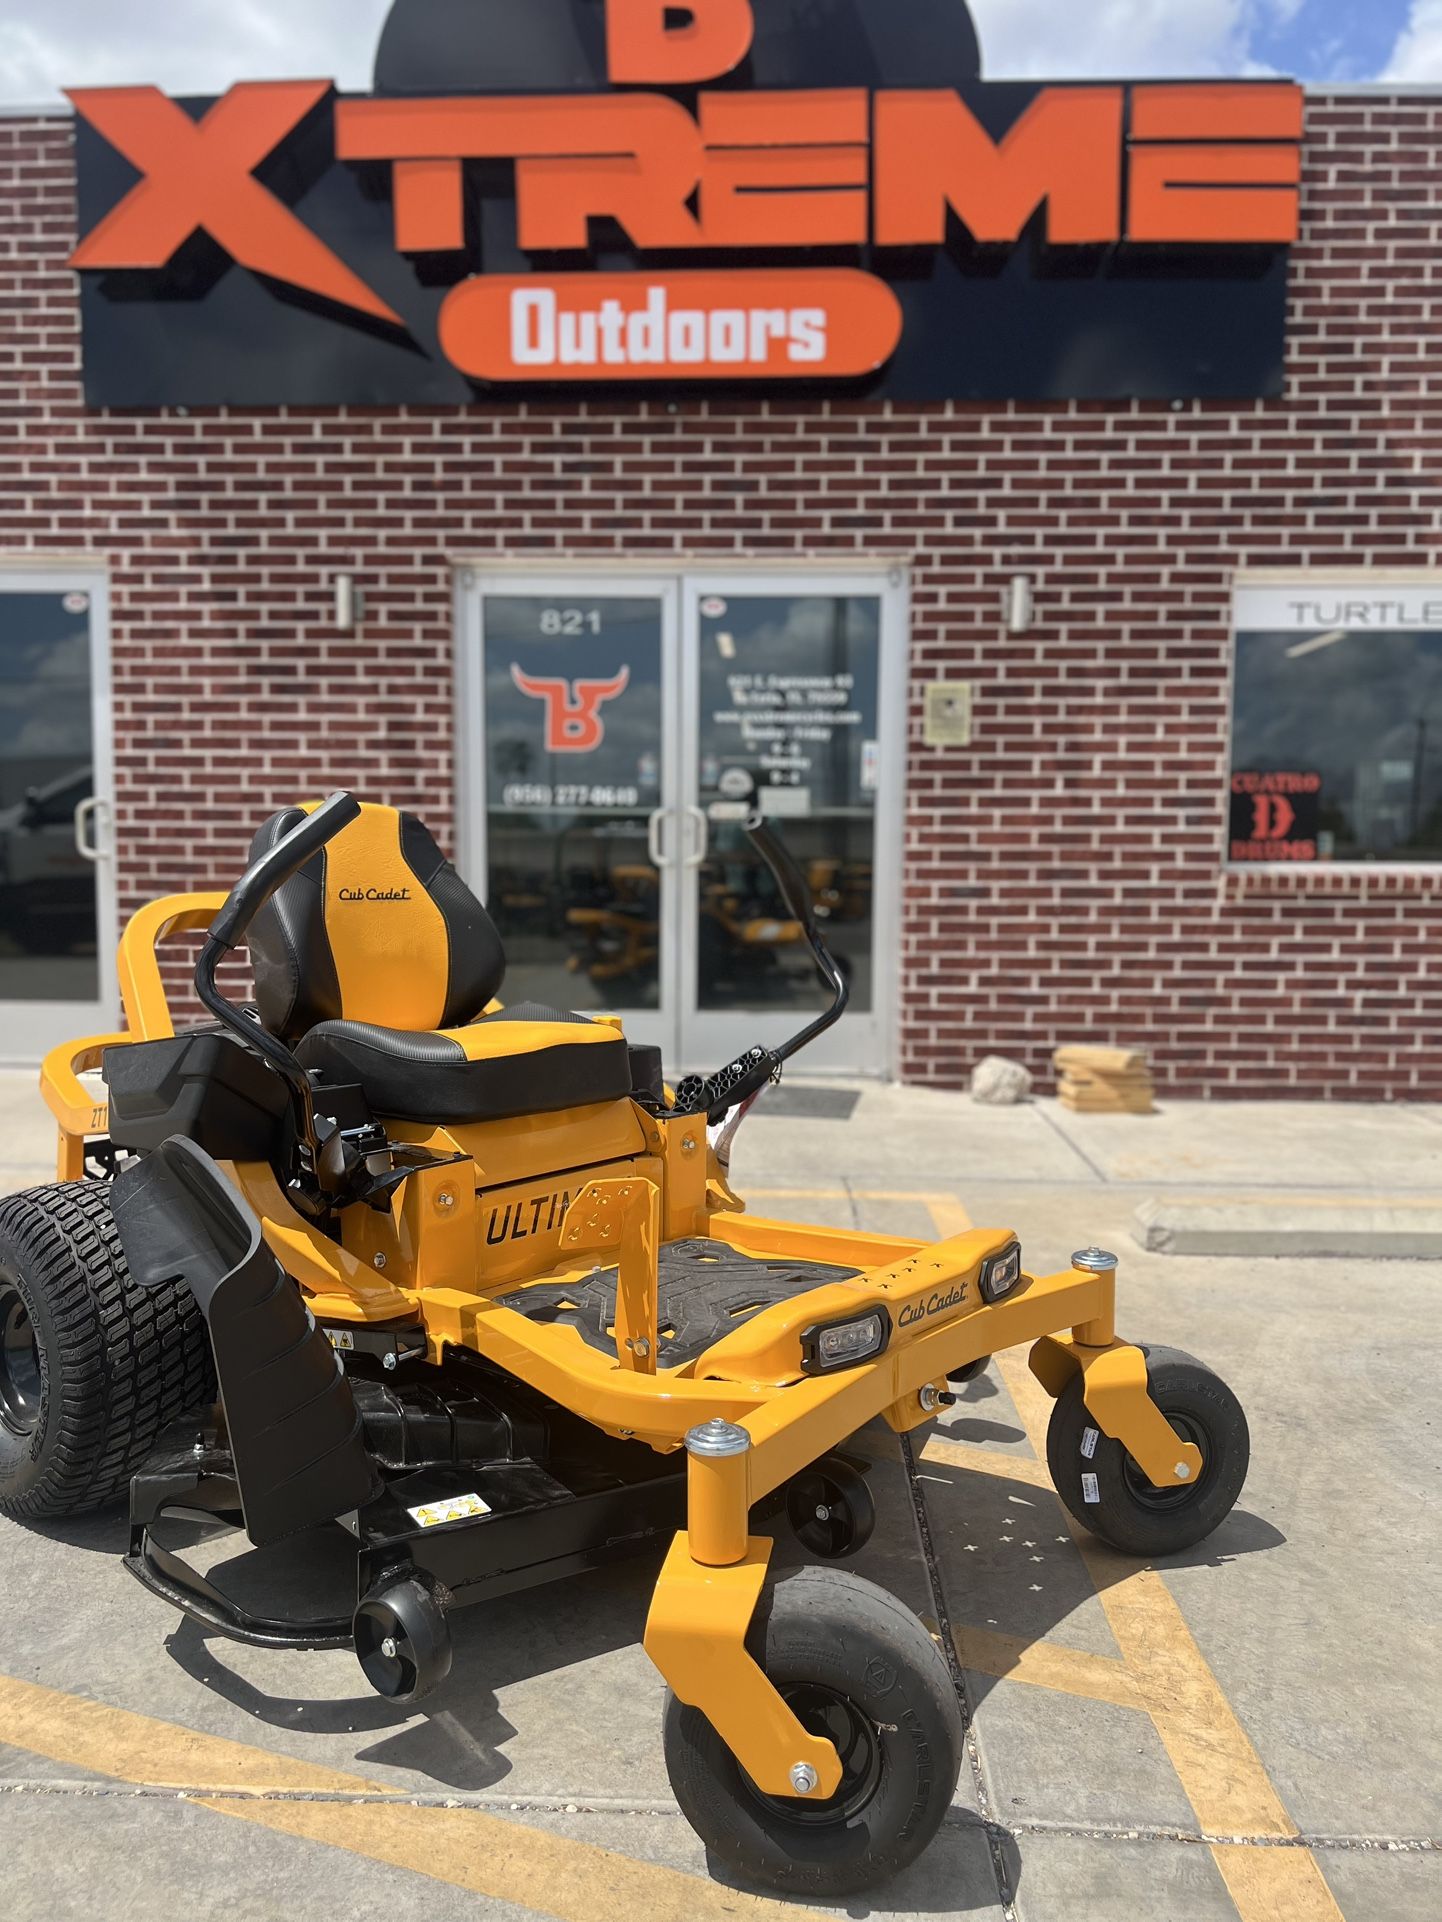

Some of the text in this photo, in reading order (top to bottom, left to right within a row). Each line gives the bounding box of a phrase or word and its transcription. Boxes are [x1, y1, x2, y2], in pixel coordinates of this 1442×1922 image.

[61, 79, 1304, 327] XTREME
[511, 286, 826, 364] Outdoors
[540, 609, 601, 635] 821
[339, 888, 411, 901] Cub Cadet
[898, 1281, 968, 1327] Cub Cadet
